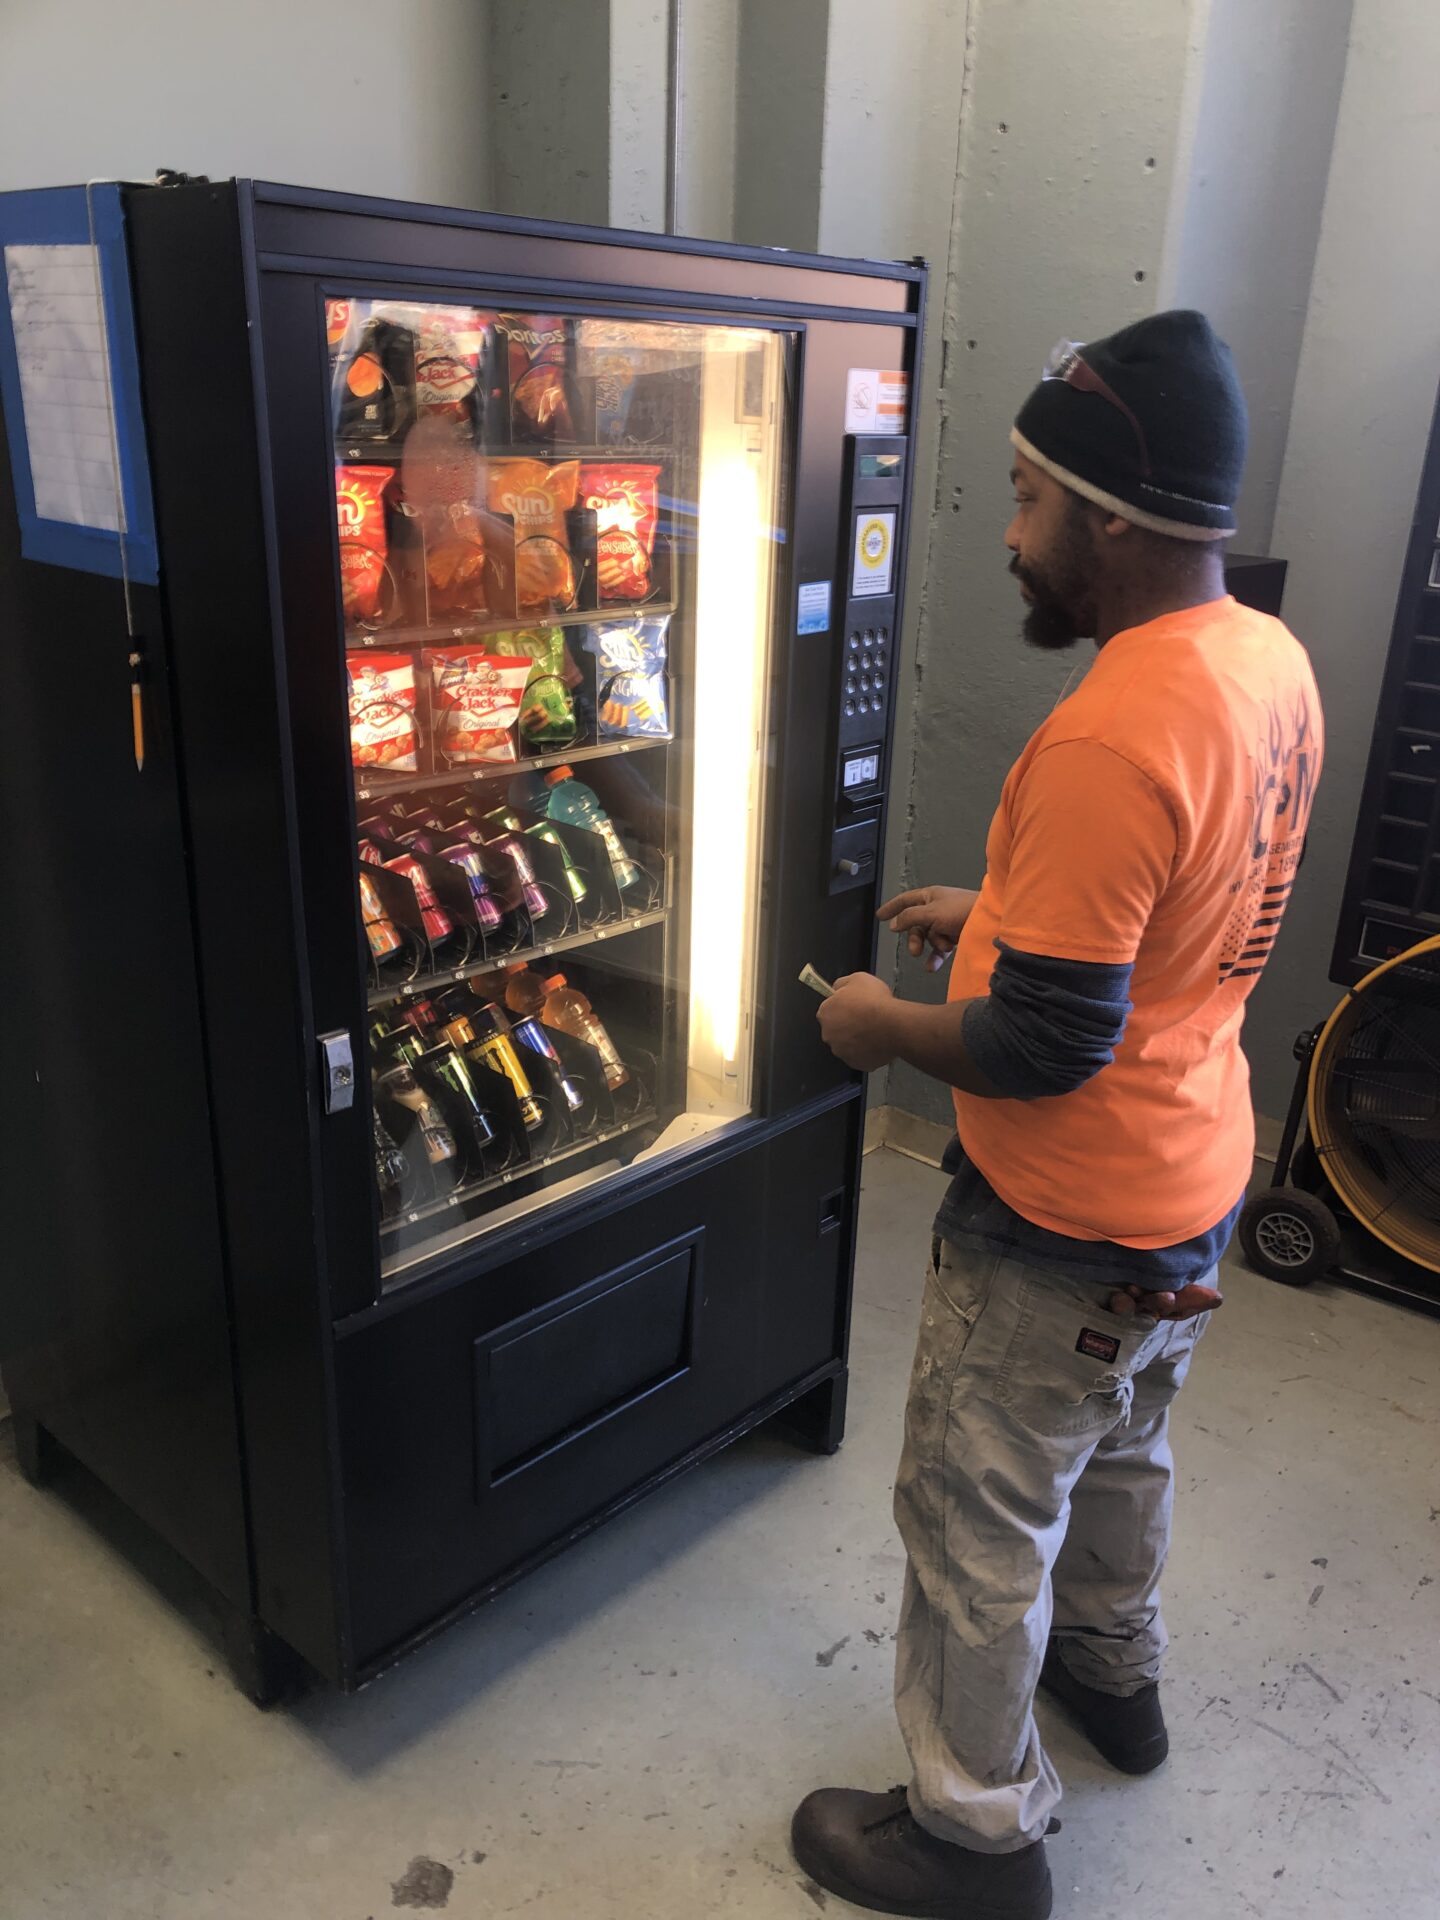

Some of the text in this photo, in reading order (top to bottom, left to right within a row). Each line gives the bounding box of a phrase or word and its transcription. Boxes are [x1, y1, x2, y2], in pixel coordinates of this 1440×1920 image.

[501, 493, 554, 515] Sun
[455, 684, 512, 700] Cracker
[462, 697, 497, 713] Jack
[462, 717, 500, 731] Original
